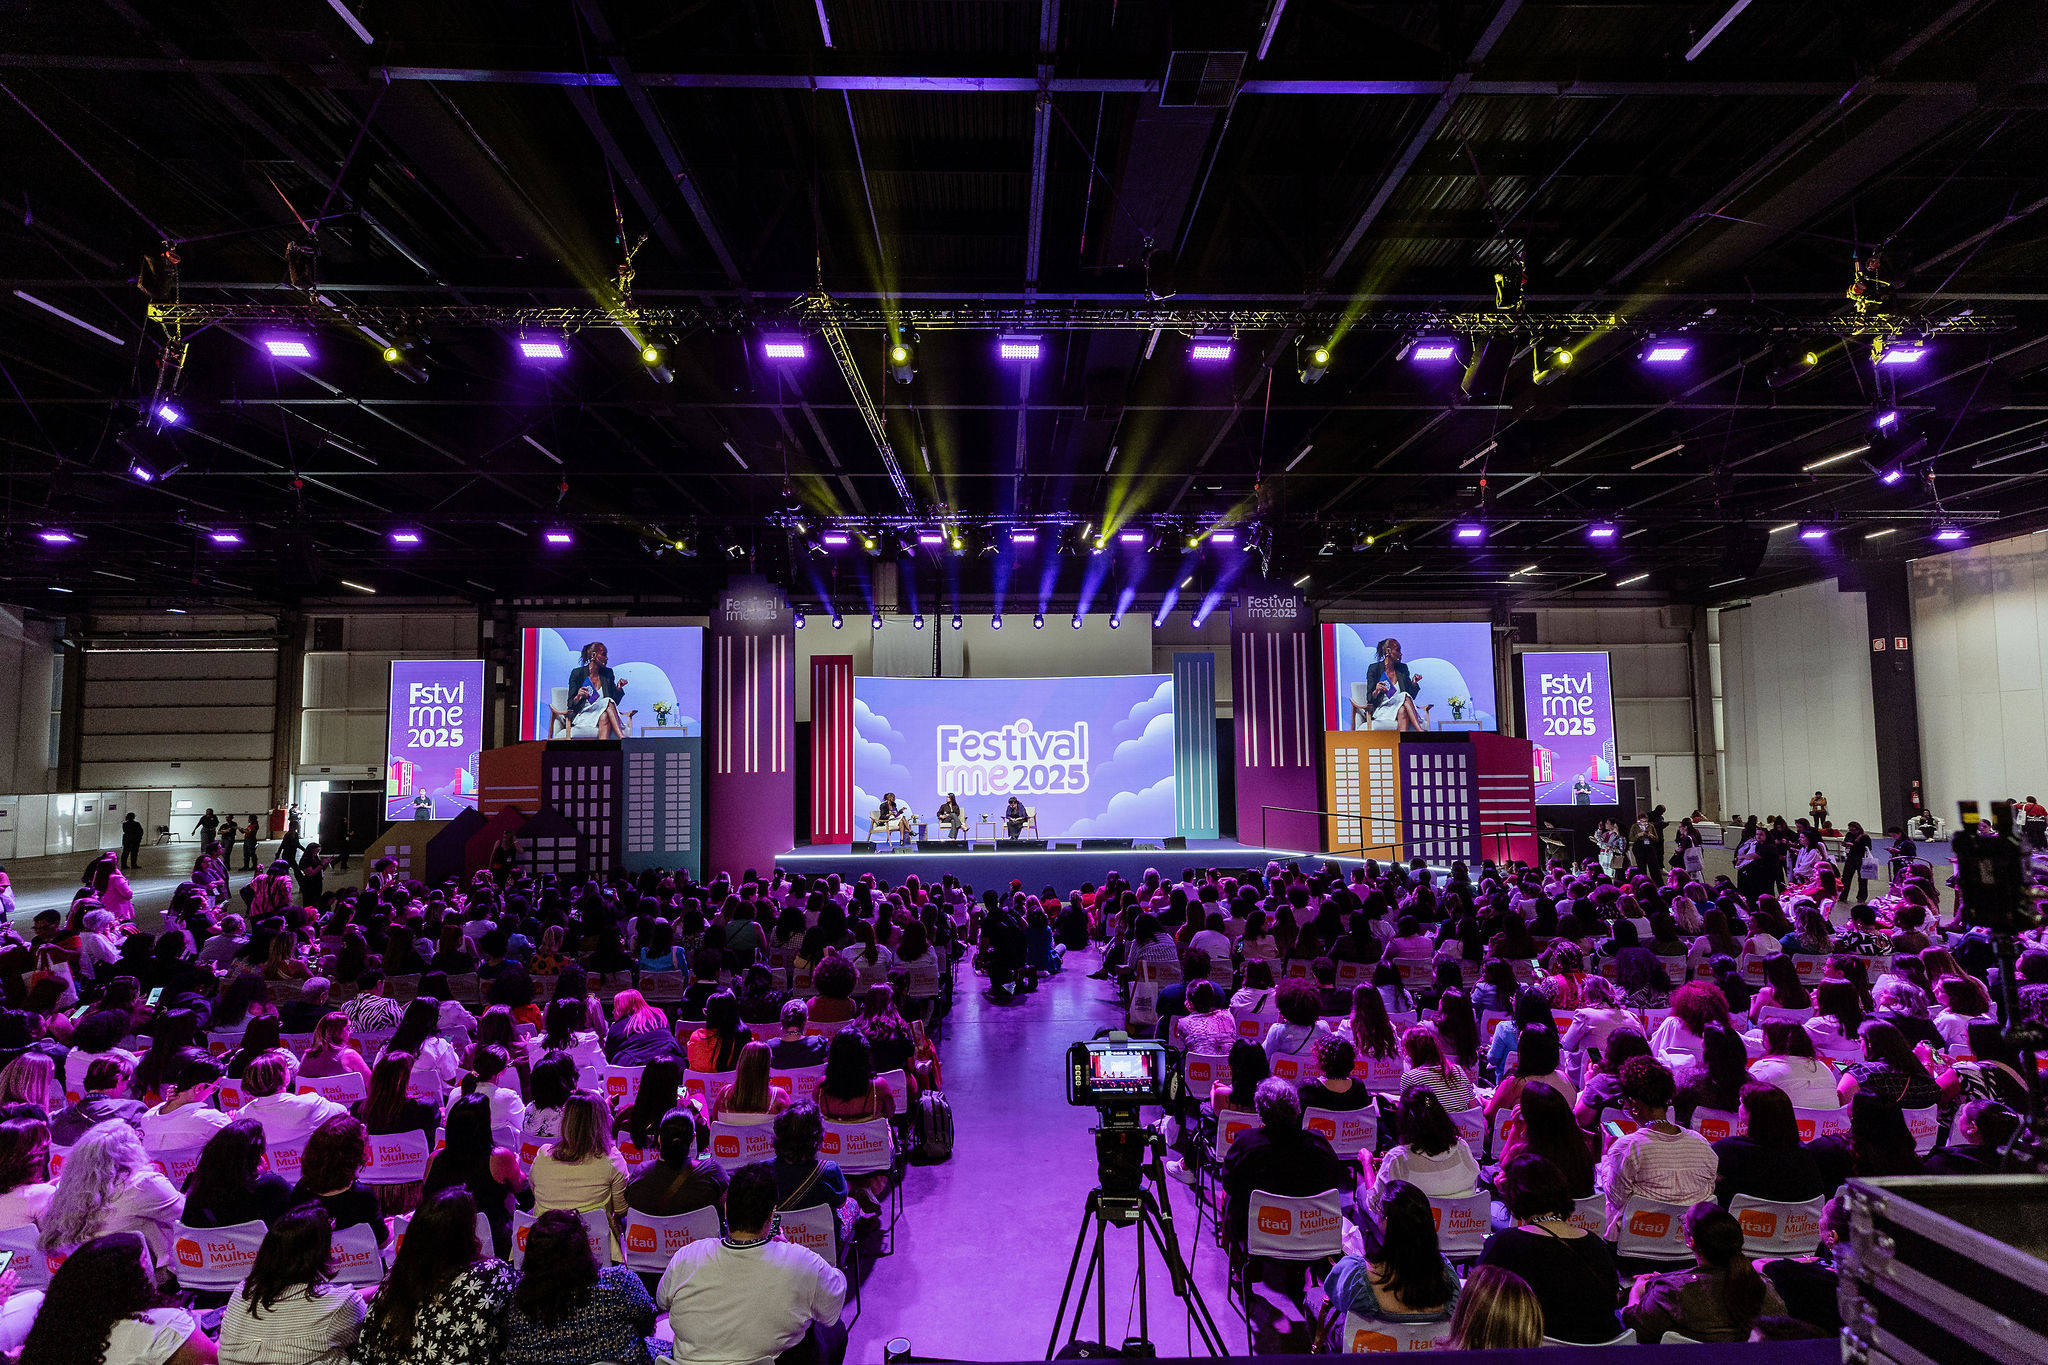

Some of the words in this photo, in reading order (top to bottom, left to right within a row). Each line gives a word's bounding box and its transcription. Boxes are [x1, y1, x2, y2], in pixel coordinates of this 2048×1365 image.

[726, 597, 778, 611] Fesal
[1248, 594, 1297, 608] Festival
[726, 610, 749, 621] rme
[749, 609, 778, 621] 25
[1248, 608, 1271, 618] rme
[1272, 608, 1297, 618] 2025
[1540, 671, 1593, 695] Fstvl
[409, 681, 465, 705] Fstvl
[1542, 693, 1594, 716] rme
[408, 703, 464, 727] rme
[1543, 717, 1597, 737] 2025
[407, 728, 465, 748] 2025
[939, 720, 1087, 762] Festival
[940, 763, 1010, 793] rme
[1013, 764, 1087, 792] 2025
[1190, 1067, 1209, 1078] itaú
[1276, 1066, 1296, 1077] itaú
[322, 1085, 342, 1093] Itaú
[608, 1082, 626, 1093] itaú
[1342, 1119, 1360, 1129] Itaú
[1822, 1119, 1840, 1129] Itaú
[1910, 1119, 1927, 1128] Itaú
[846, 1133, 866, 1143] Itaú
[1342, 1126, 1373, 1138] Mulher
[1702, 1127, 1727, 1138] itaú
[746, 1134, 766, 1144] Itaú
[847, 1139, 883, 1151] Mulher
[379, 1144, 401, 1154] Itaú
[716, 1143, 738, 1154] itaú
[821, 1141, 839, 1151] taú
[273, 1148, 297, 1158] Itaú
[380, 1151, 421, 1162] Mulher
[1300, 1208, 1322, 1219] Itaú
[1450, 1208, 1472, 1219] Itaú
[1568, 1212, 1585, 1222] taú
[1786, 1212, 1808, 1223] Itaú
[1261, 1216, 1289, 1231] itaú
[1300, 1215, 1341, 1230] Mulher
[1448, 1216, 1487, 1229] Mulher
[1632, 1220, 1665, 1233] itaú
[1741, 1220, 1772, 1233] itaú
[664, 1226, 689, 1238] Itaú
[207, 1240, 236, 1253] Itaú
[629, 1235, 655, 1248] itaú
[179, 1248, 202, 1263] itaú
[210, 1249, 258, 1264] Mulhe
